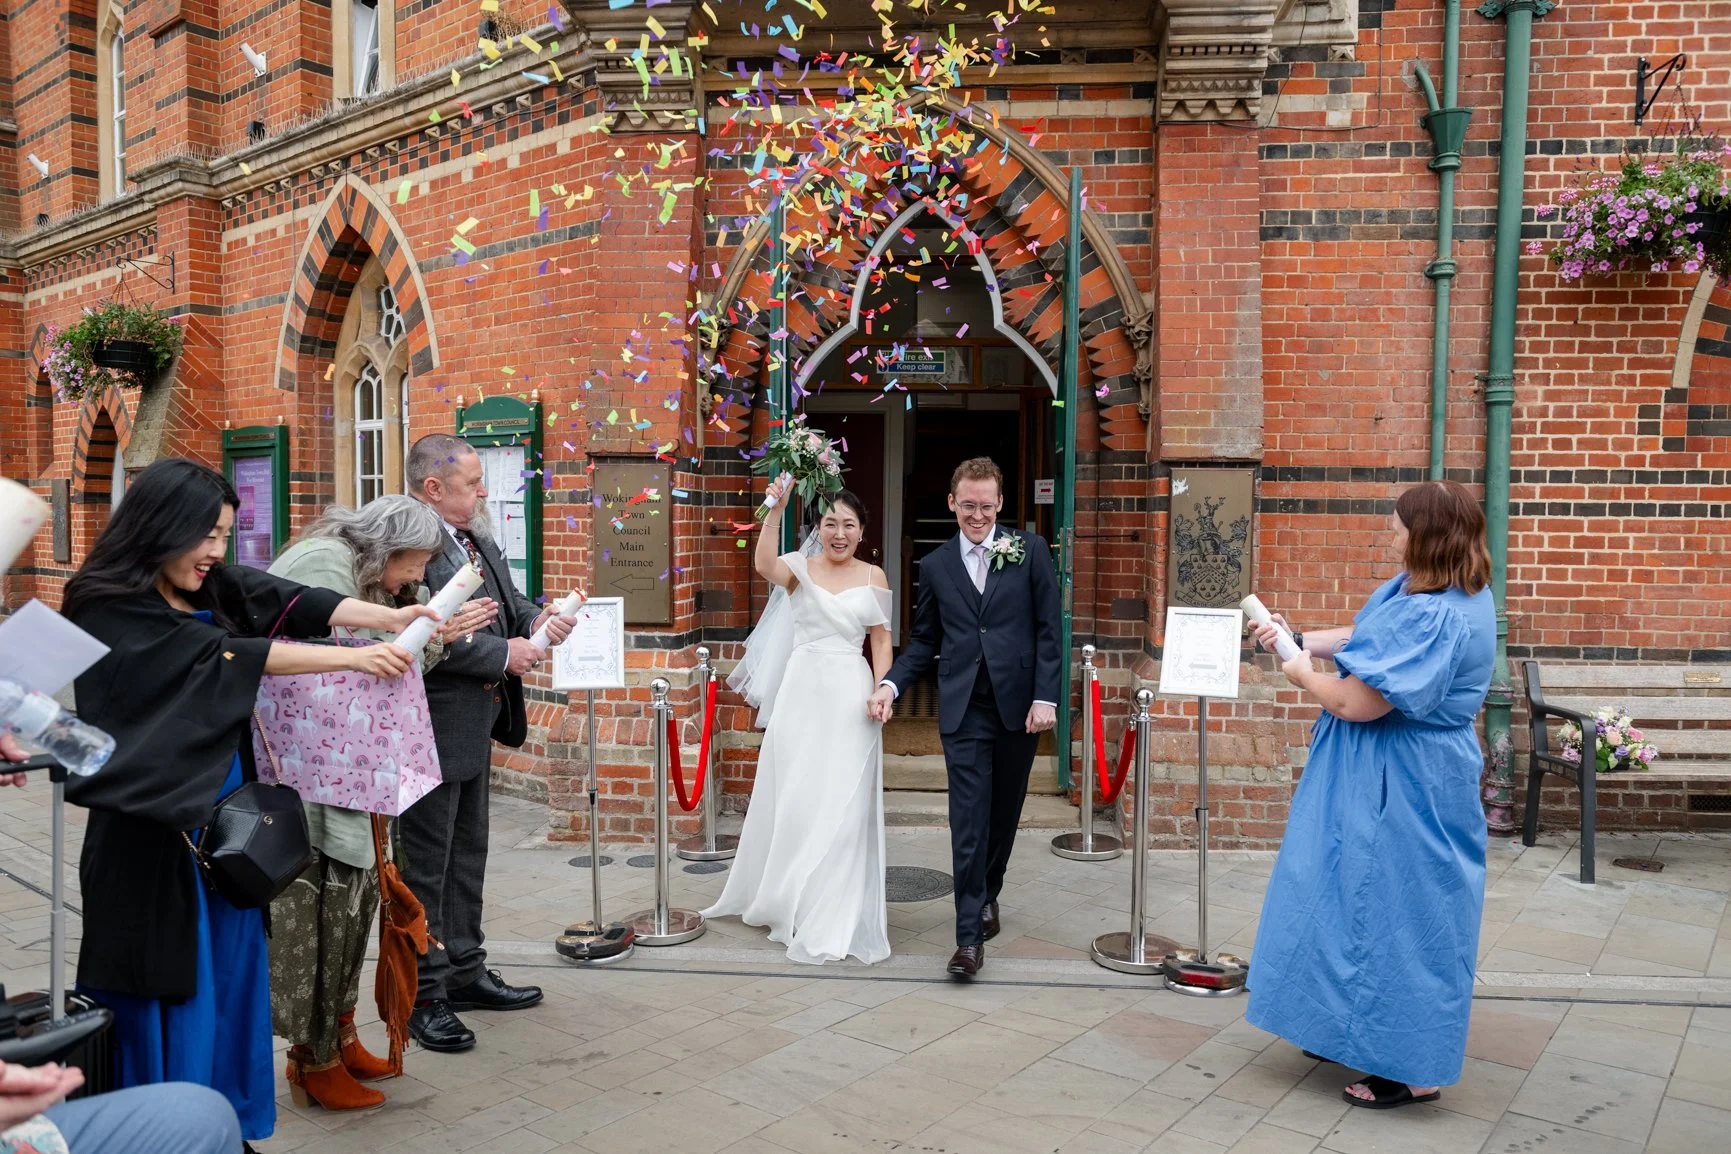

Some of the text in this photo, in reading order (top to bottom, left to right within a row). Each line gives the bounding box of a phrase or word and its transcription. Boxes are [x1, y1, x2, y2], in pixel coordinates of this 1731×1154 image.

[900, 353, 916, 361] ire
[896, 363, 915, 371] Keep
[618, 510, 645, 519] Town
[613, 526, 651, 535] Council
[619, 542, 645, 551] Main
[610, 558, 654, 567] Entrance
